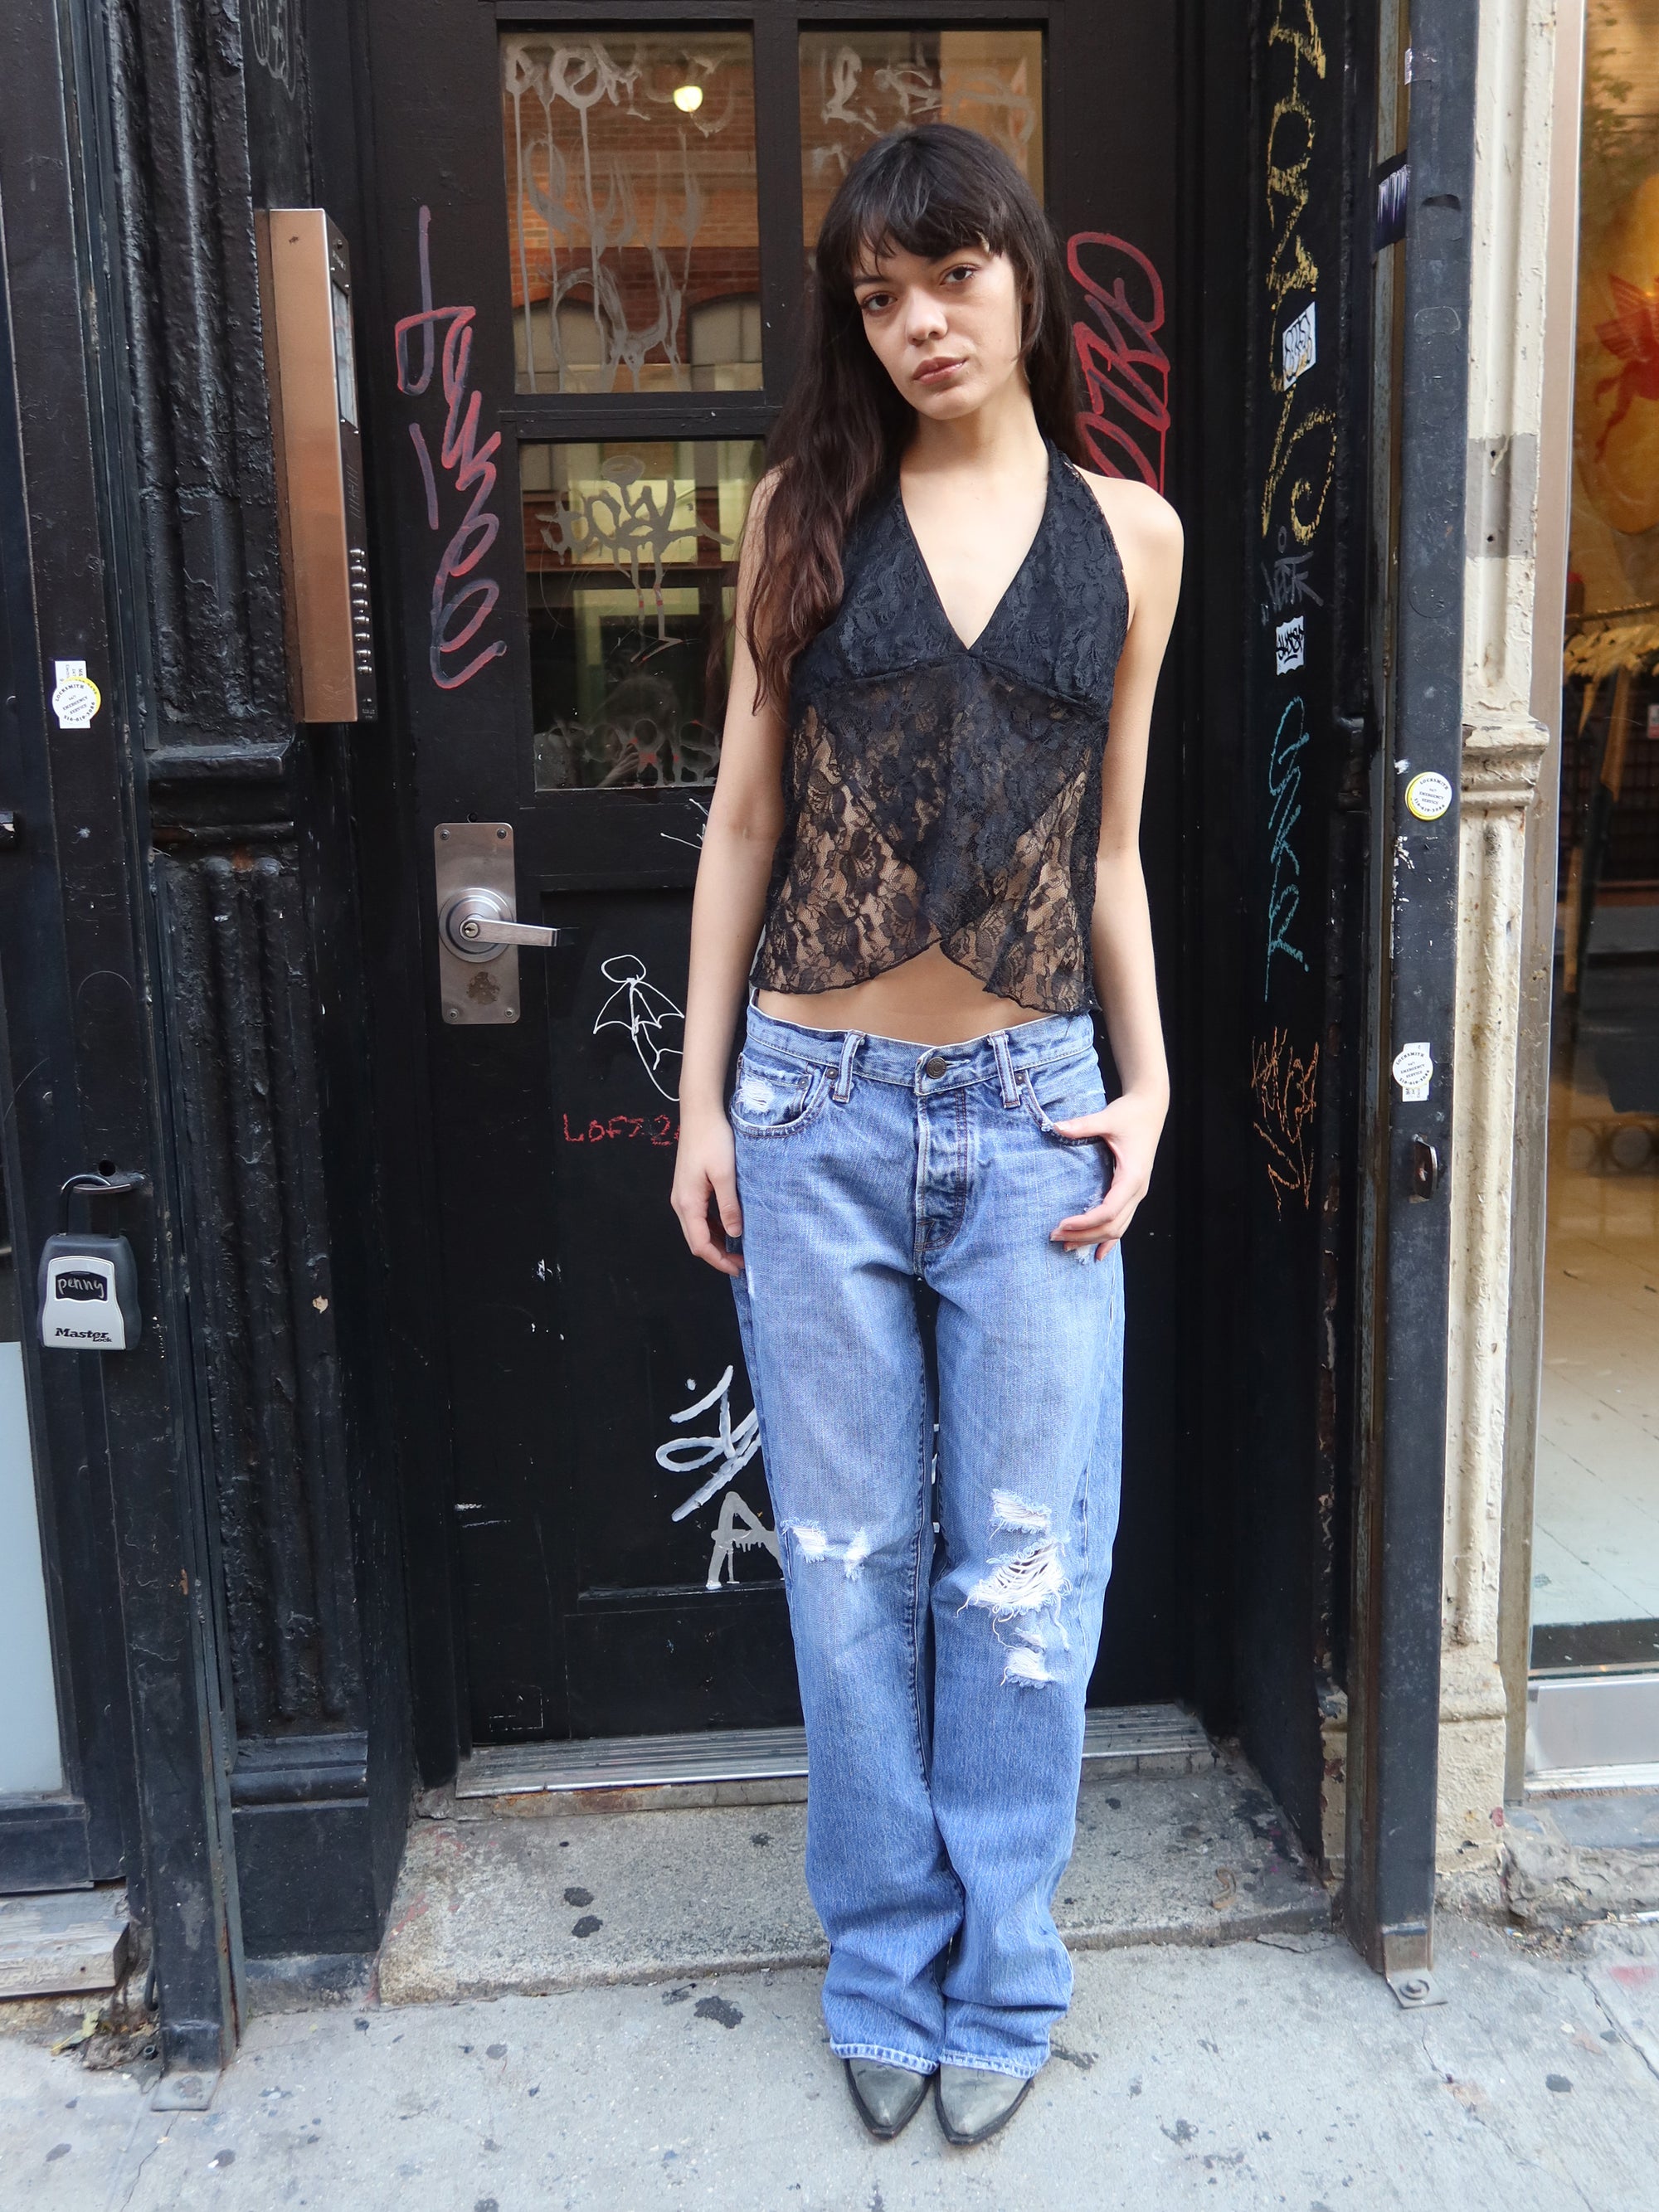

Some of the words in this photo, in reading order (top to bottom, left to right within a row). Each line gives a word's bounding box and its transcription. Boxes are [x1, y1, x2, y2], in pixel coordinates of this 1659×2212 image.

[55, 683, 85, 702] LOCKSMITH
[62, 696, 88, 711] EMERGENCY
[70, 703, 87, 714] SERVICE
[1419, 778, 1449, 790] LOCKSMITH
[1395, 1052, 1425, 1065] LOCKSMITH
[1400, 1063, 1425, 1074] EMERGENCY
[1405, 1070, 1423, 1078] SERVICE
[57, 1278, 105, 1299] penny
[55, 1328, 109, 1338] Master
